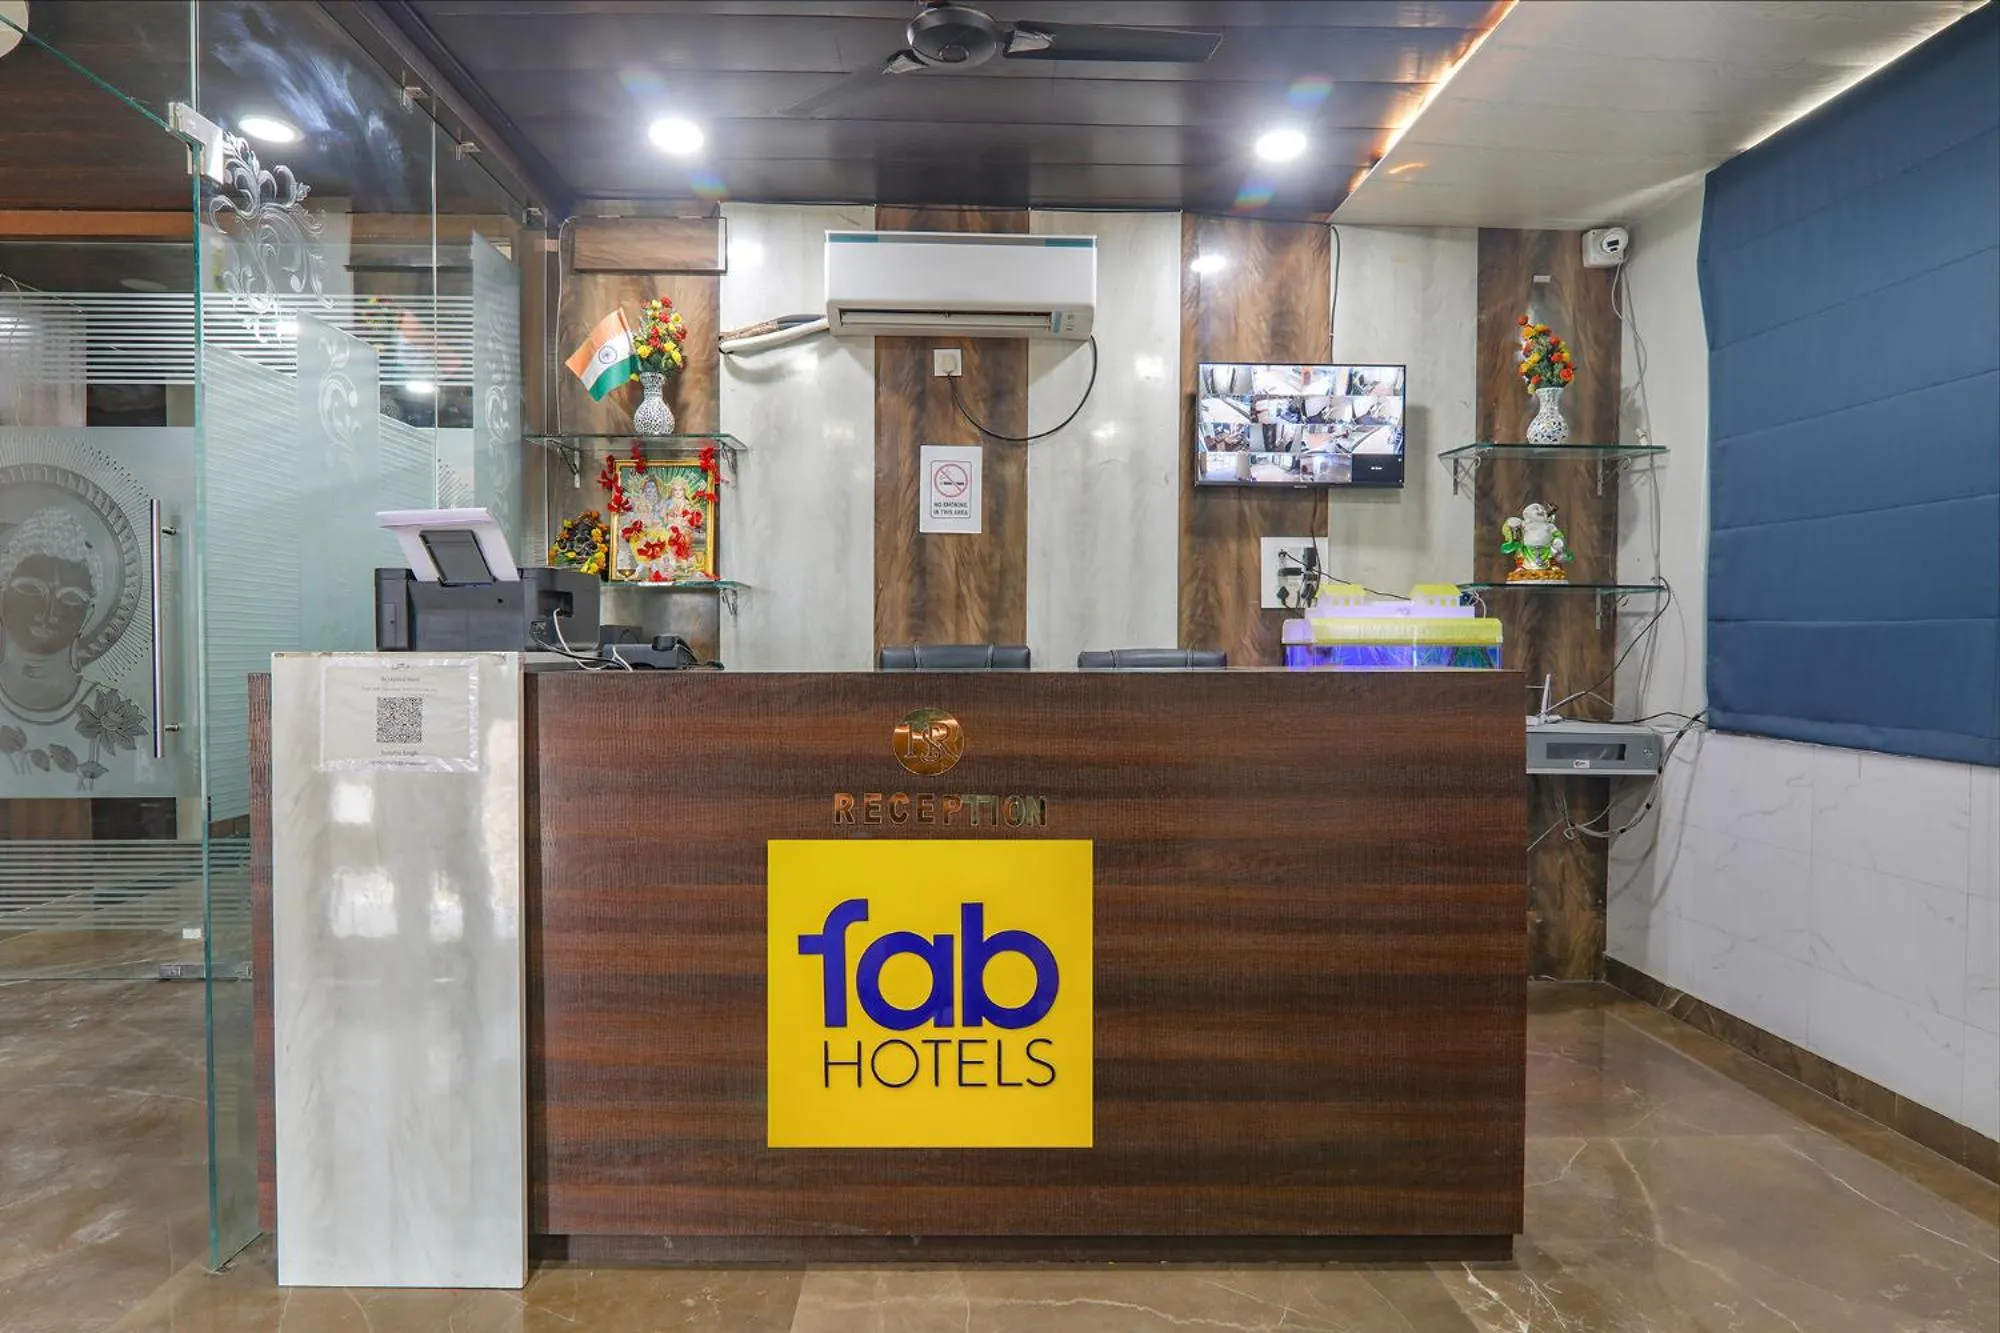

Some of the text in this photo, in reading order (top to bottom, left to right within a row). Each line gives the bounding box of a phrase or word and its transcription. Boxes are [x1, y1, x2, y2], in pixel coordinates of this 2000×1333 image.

[834, 792, 1048, 828] RECEPTION
[798, 898, 1060, 1031] fab
[823, 1038, 1056, 1088] HOTELS
